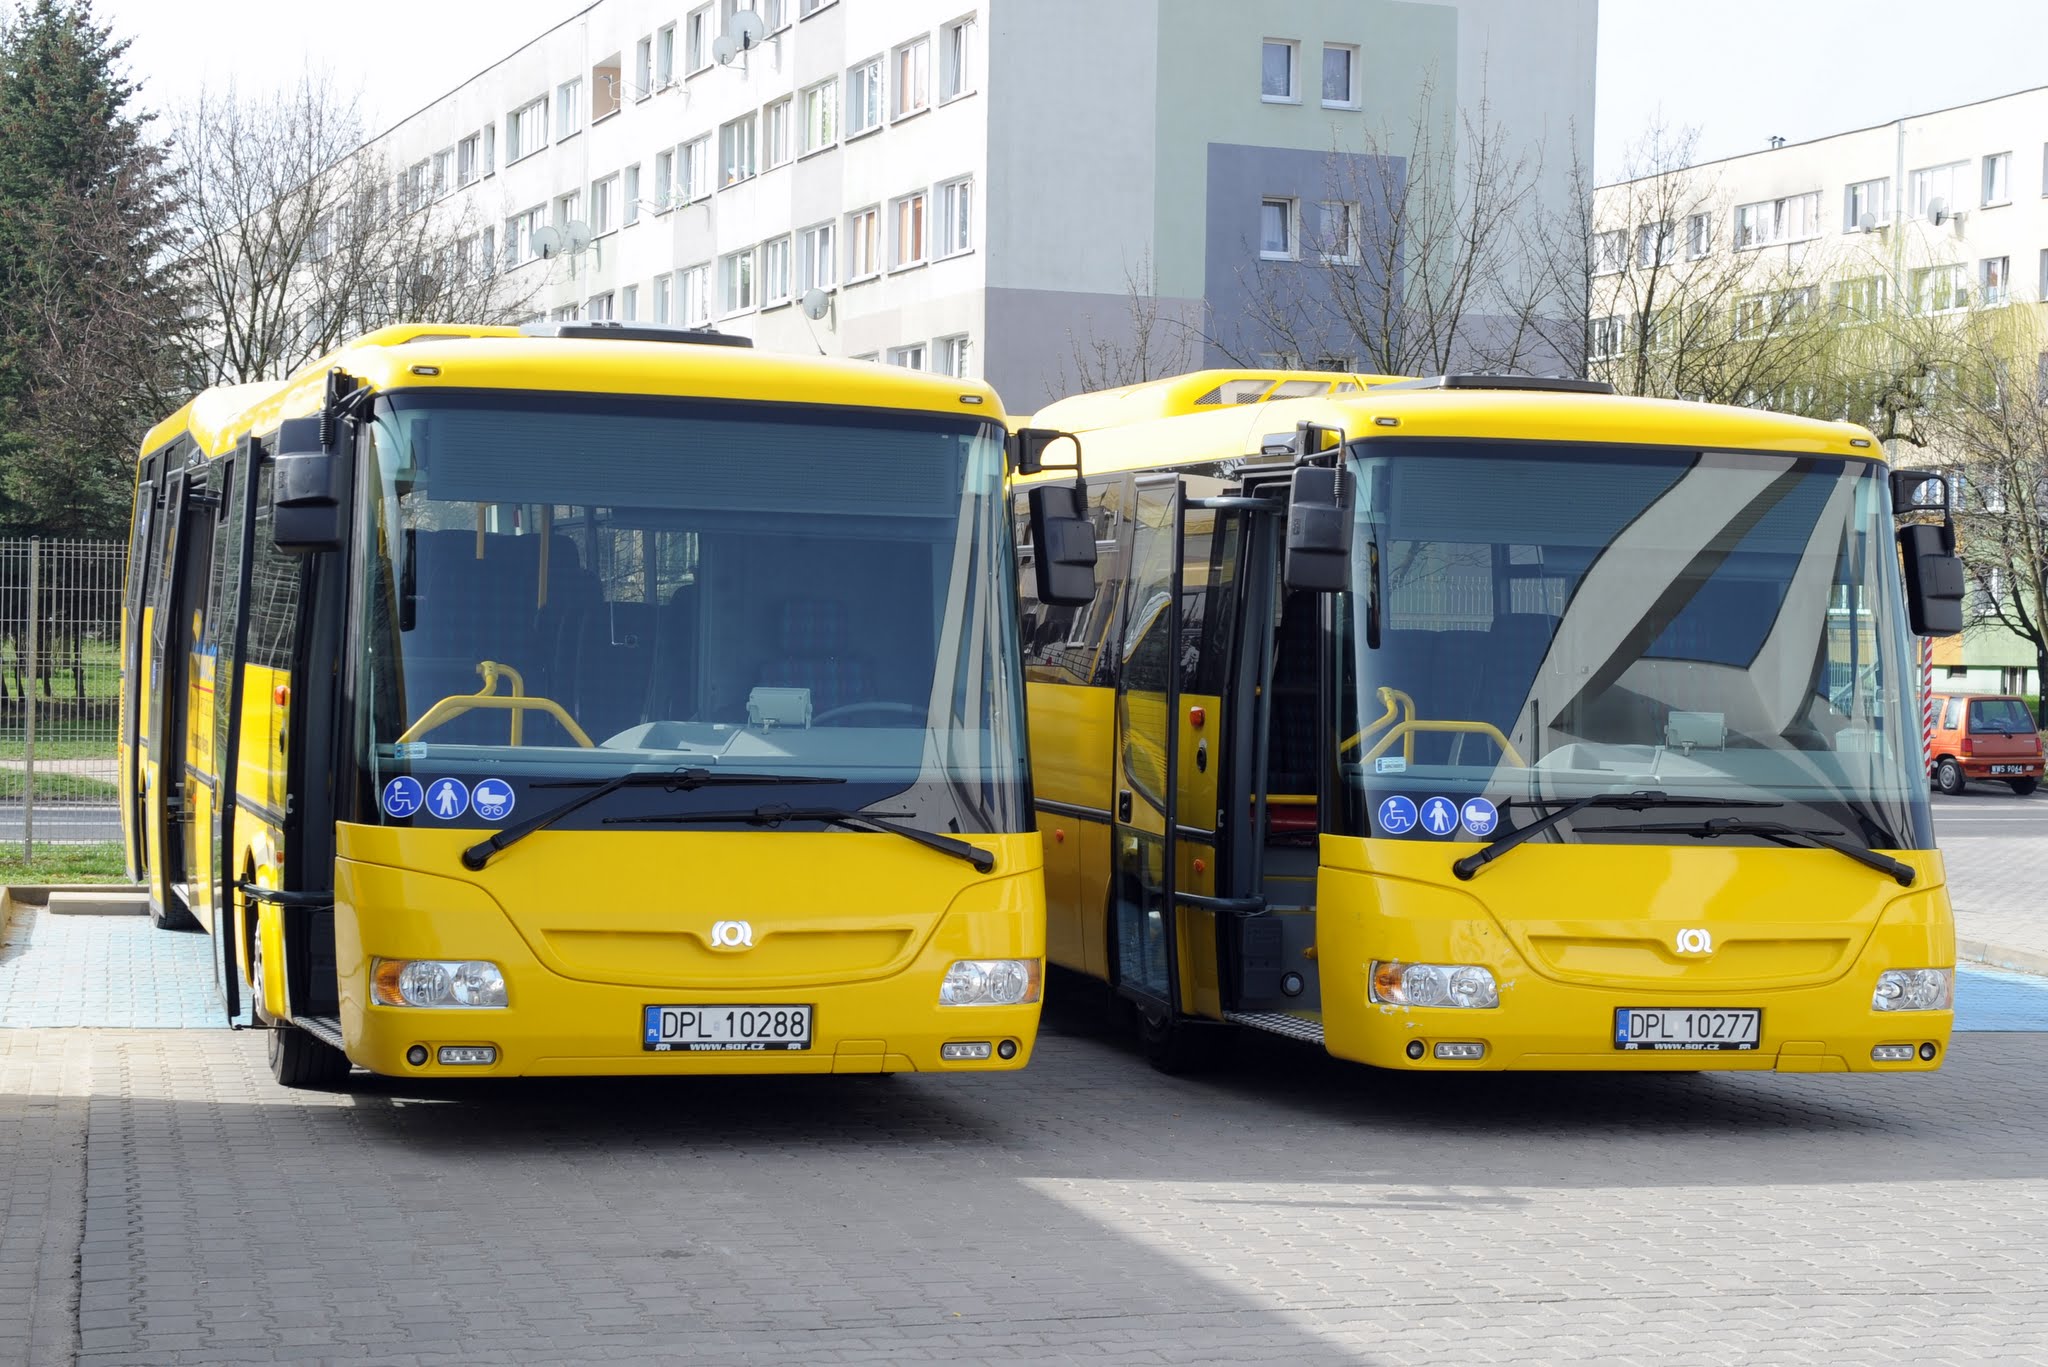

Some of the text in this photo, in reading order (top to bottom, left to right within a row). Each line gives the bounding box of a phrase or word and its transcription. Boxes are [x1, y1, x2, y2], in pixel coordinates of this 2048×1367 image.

[662, 1011, 804, 1038] DPL 10288
[1630, 1013, 1755, 1038] DPL 10277
[648, 1028, 658, 1036] PL
[1619, 1029, 1628, 1037] PL
[690, 1043, 765, 1051] www.sor.cz
